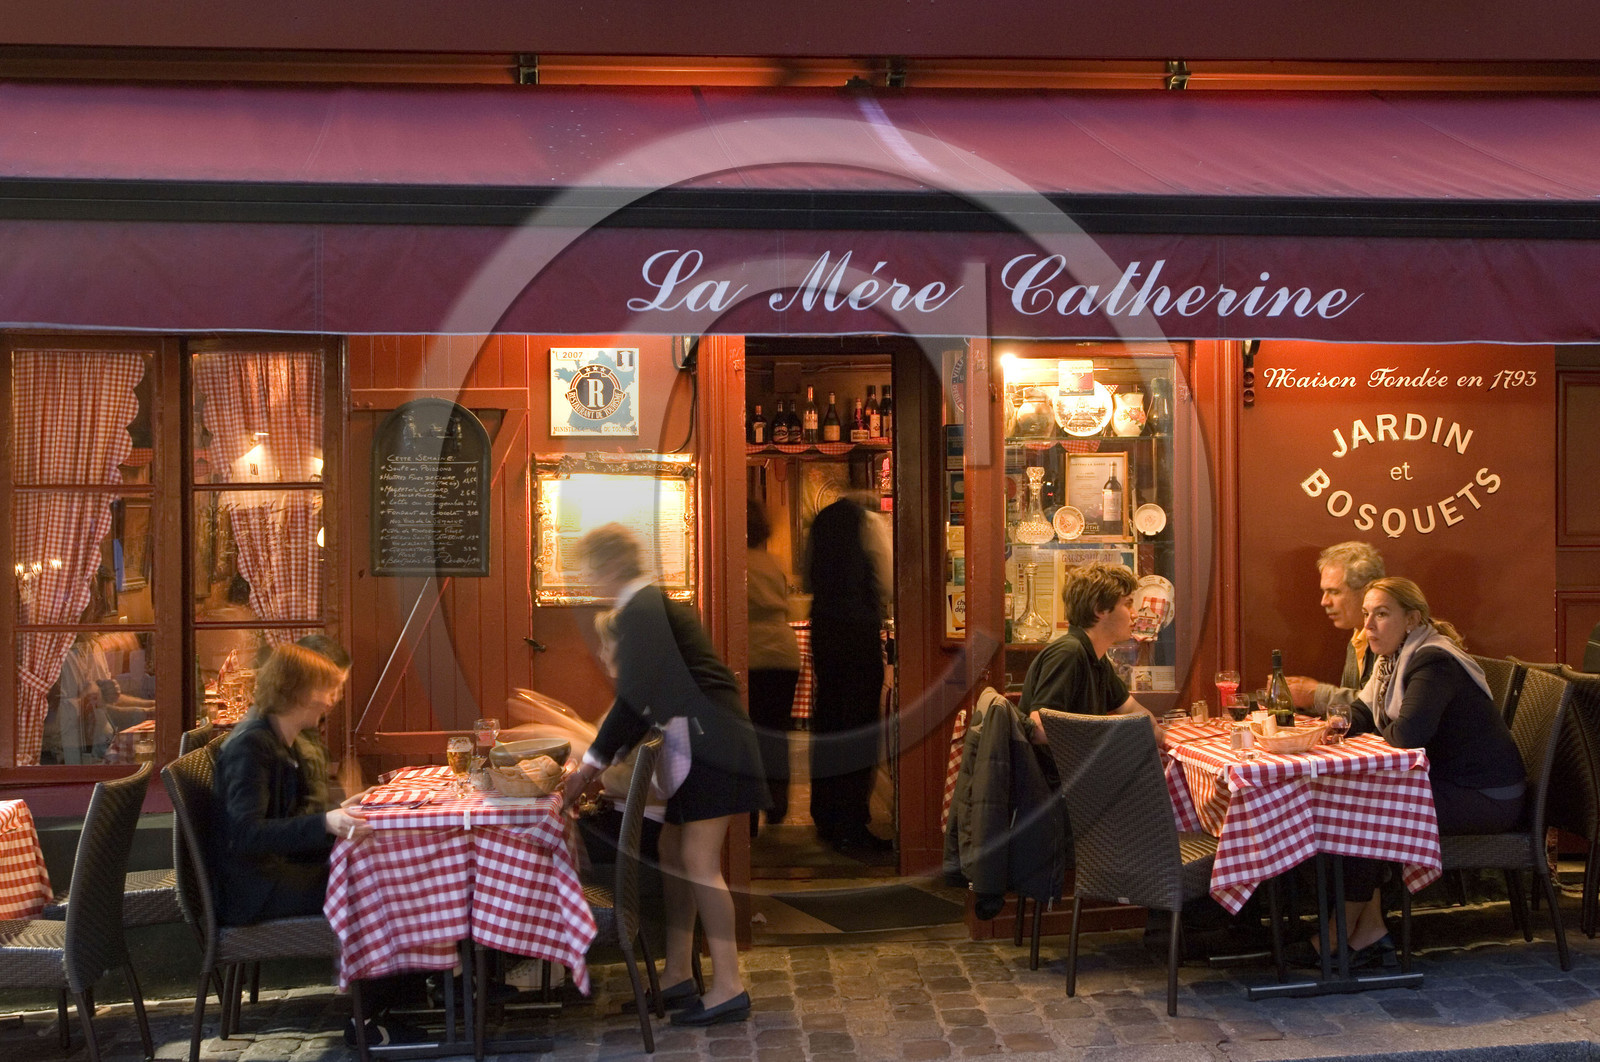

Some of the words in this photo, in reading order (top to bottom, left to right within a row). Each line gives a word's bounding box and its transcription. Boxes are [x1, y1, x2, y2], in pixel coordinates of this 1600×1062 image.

[627, 249, 748, 312] La
[768, 249, 964, 312] Mére
[1001, 253, 1364, 319] Catherine
[562, 351, 583, 359] 2007
[586, 378, 605, 408] R
[1263, 367, 1357, 389] Maison
[1367, 366, 1448, 389] Fondée
[1456, 375, 1484, 388] en
[1489, 369, 1537, 391] 1793
[567, 391, 594, 419] RESTAURANT
[604, 391, 623, 416] TOURISME
[1332, 413, 1474, 458] JARDIN
[1390, 462, 1413, 481] et
[1301, 467, 1501, 538] BOSQUETS
